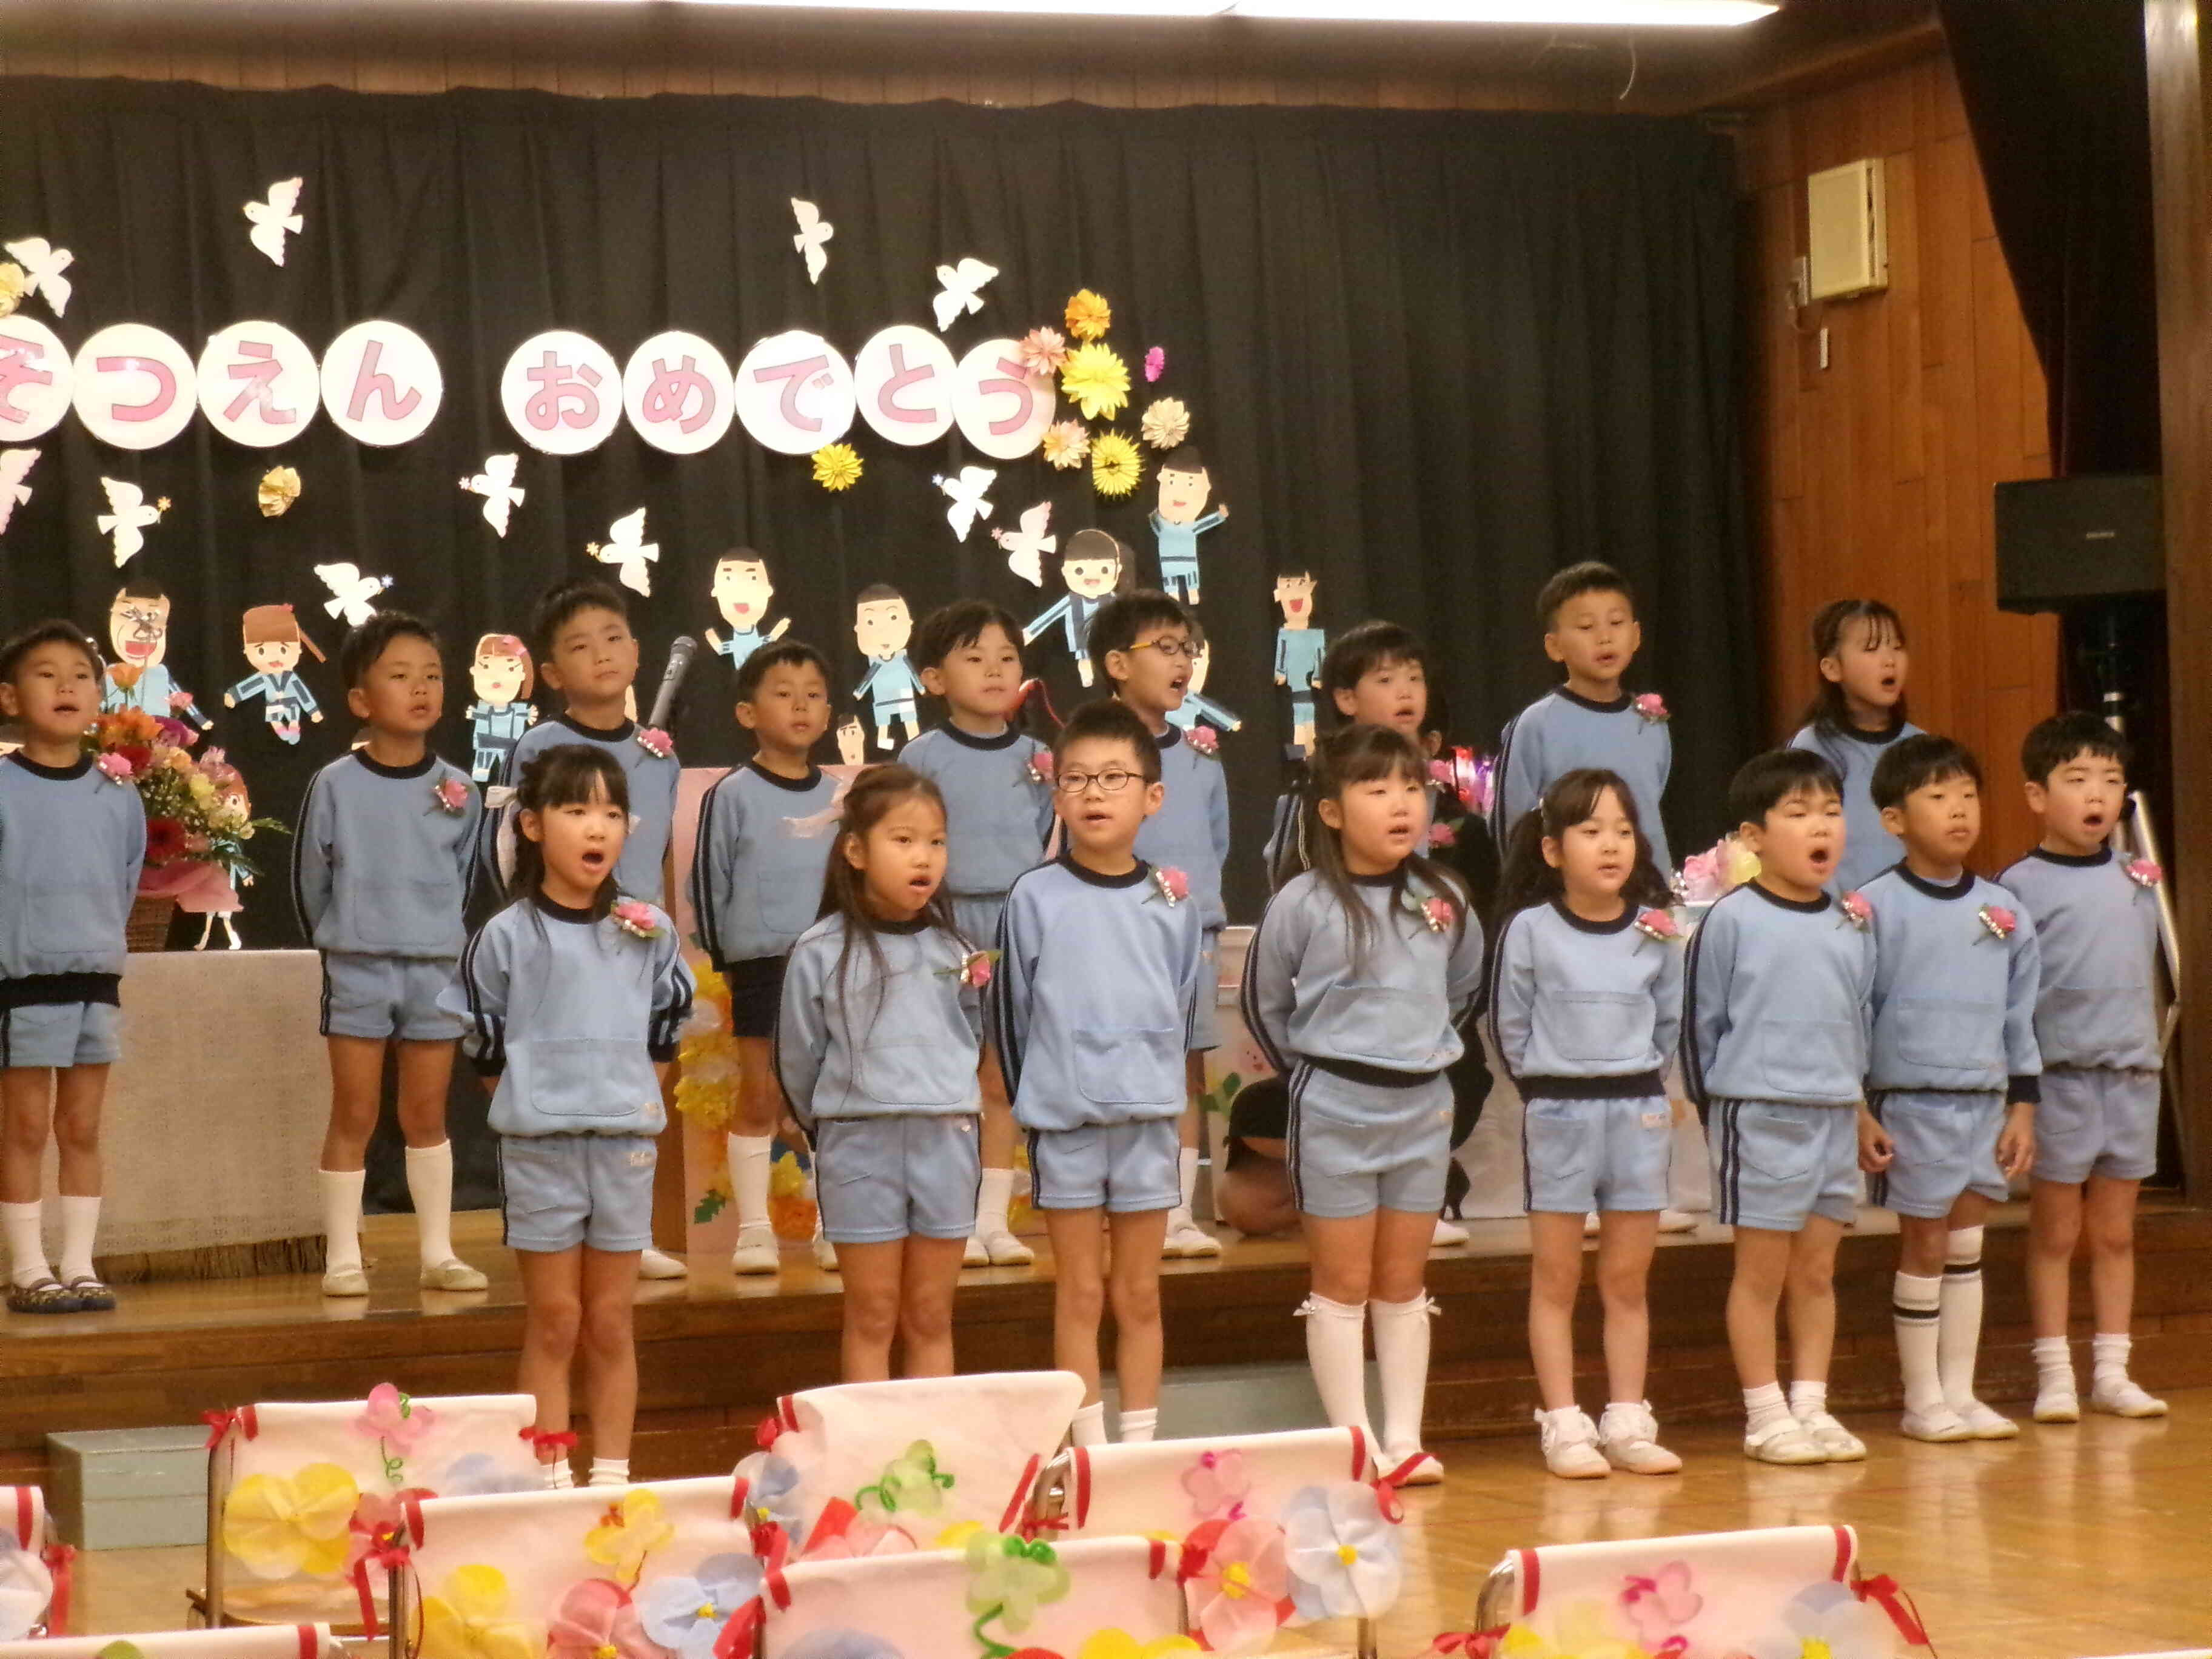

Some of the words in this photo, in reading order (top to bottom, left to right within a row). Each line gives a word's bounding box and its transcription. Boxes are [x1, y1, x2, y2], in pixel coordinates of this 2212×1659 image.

[525, 343, 1034, 436] おめでとう
